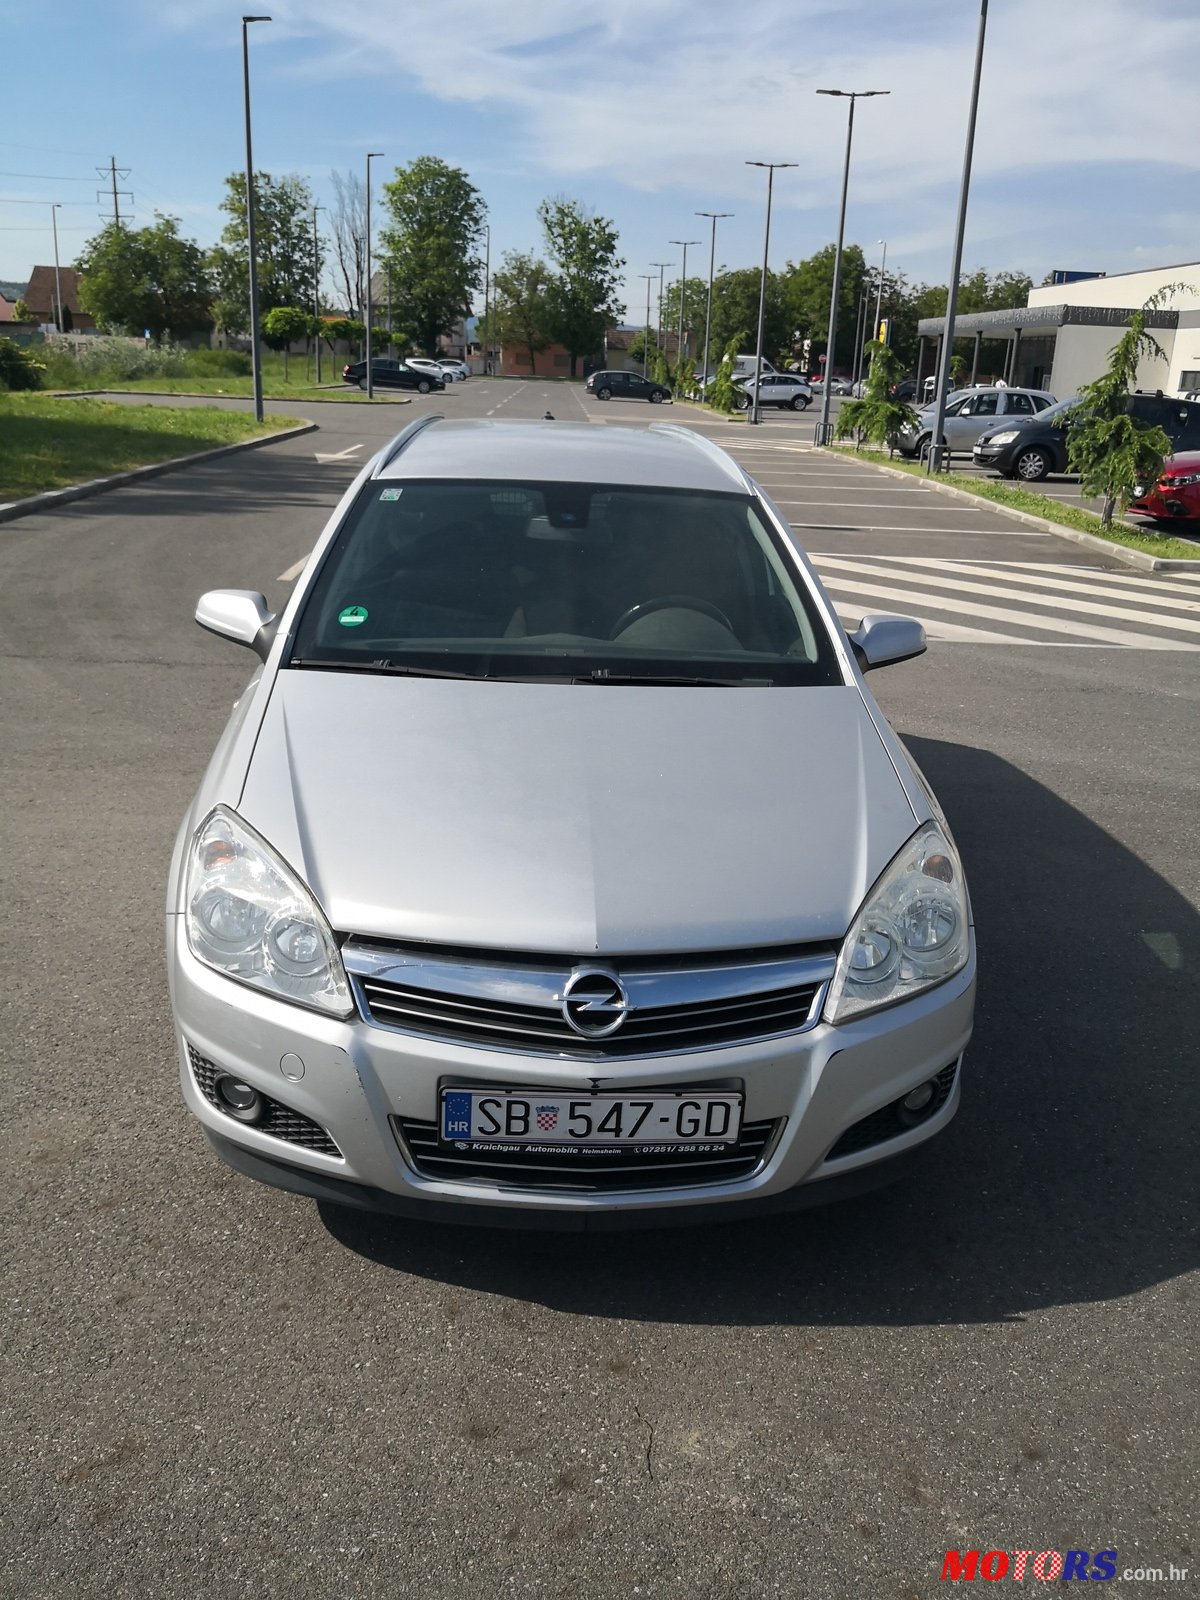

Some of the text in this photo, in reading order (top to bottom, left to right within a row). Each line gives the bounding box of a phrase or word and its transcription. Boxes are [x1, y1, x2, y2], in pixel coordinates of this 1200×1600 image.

[350, 606, 358, 616] 4
[478, 1099, 730, 1138] SB 547-GD
[448, 1121, 468, 1132] HR
[472, 1143, 520, 1152] Kraichgau
[525, 1144, 578, 1154] Automobile
[642, 1145, 676, 1153] 07251/
[698, 1144, 711, 1152] 96
